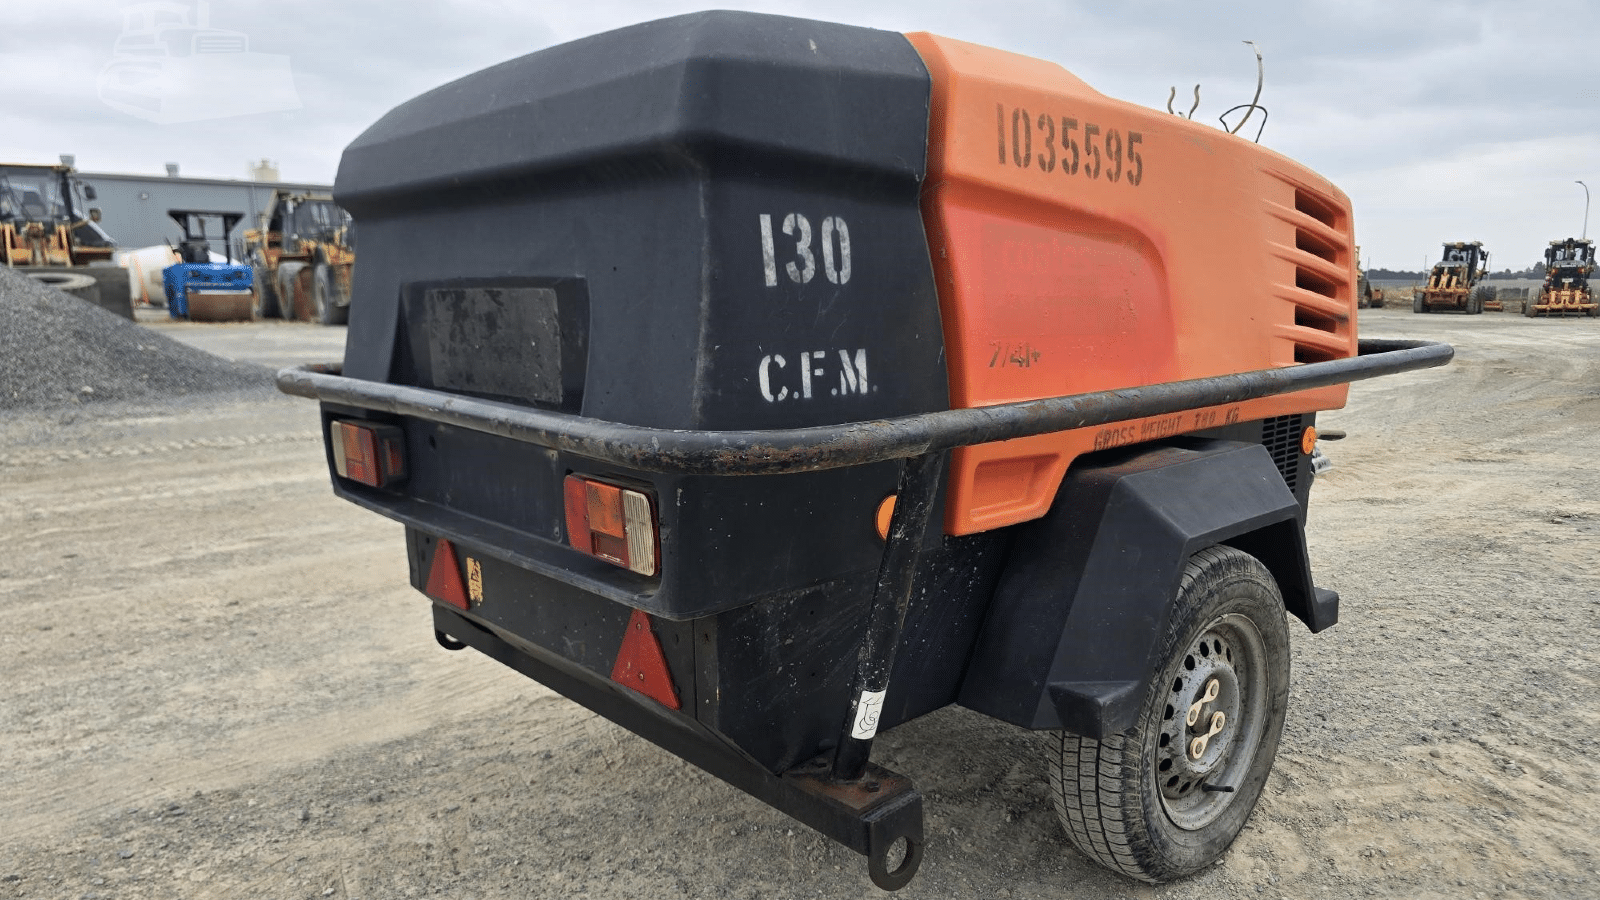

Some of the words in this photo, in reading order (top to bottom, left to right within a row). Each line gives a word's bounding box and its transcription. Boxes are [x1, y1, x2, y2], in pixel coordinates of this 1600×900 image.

[996, 102, 1143, 187] 1035595
[759, 212, 852, 286] 130
[1093, 425, 1136, 451] GROSS
[1140, 415, 1183, 441] WEIGHT
[1225, 405, 1240, 425] KG
